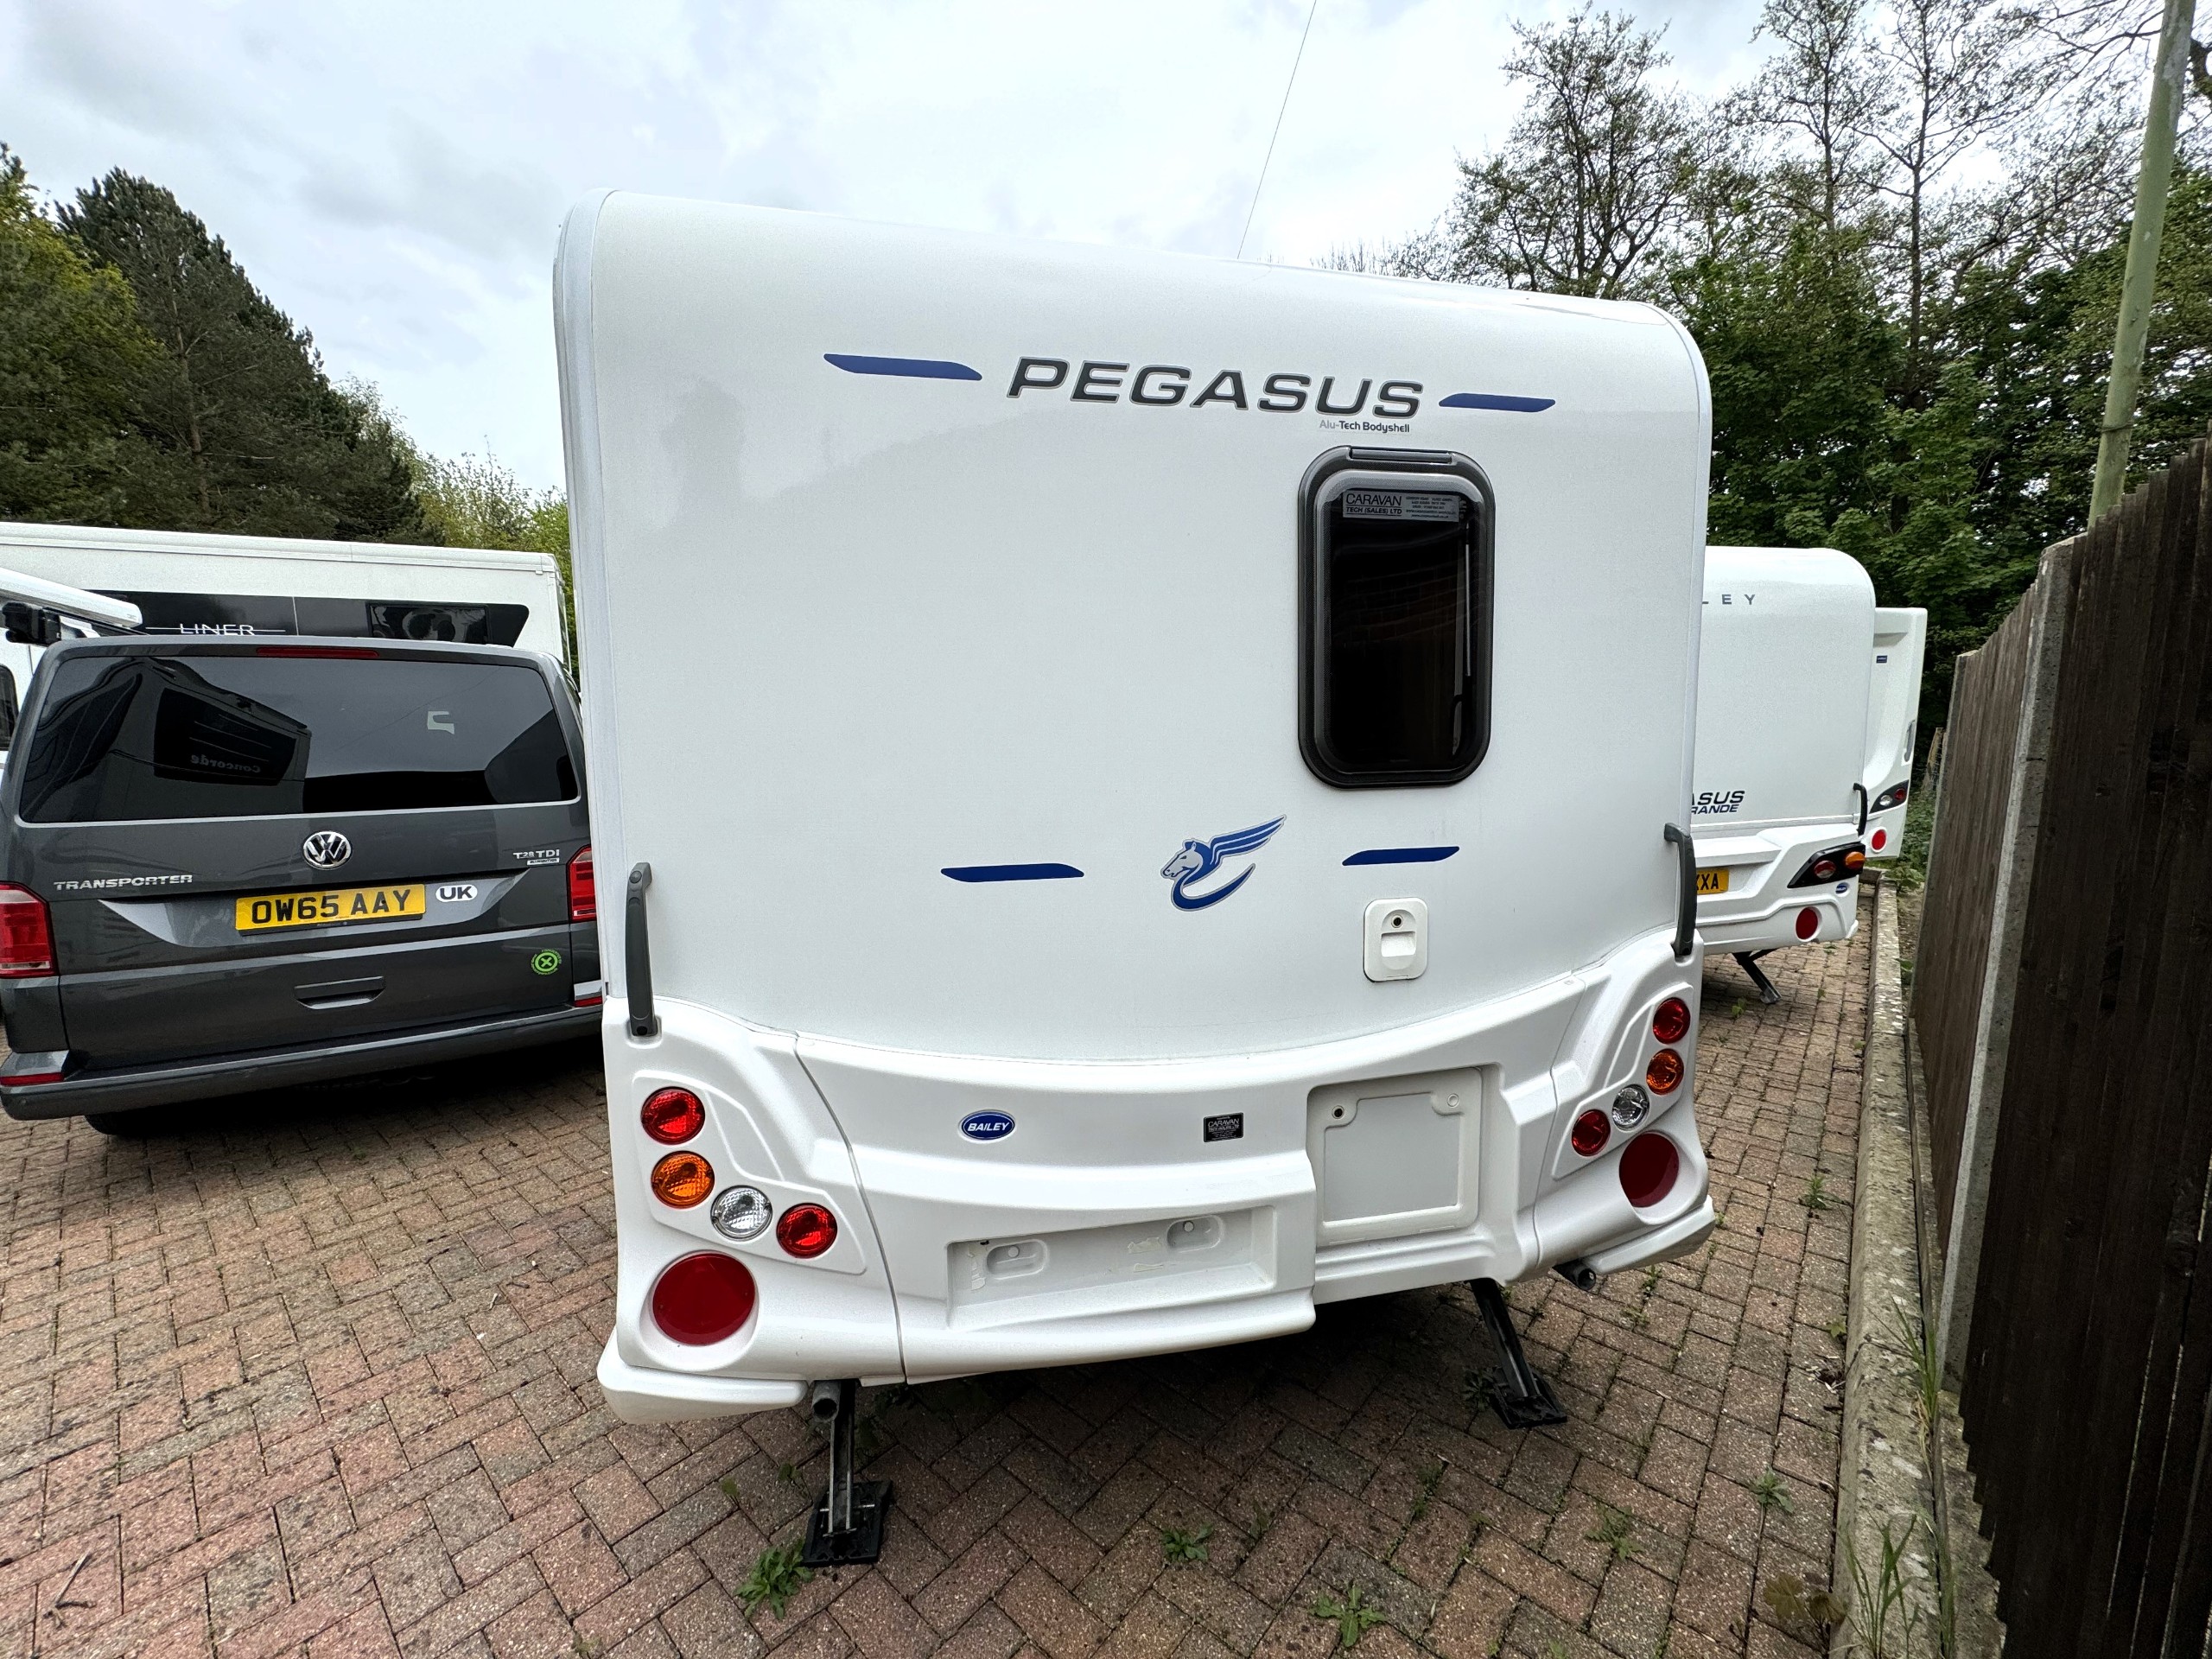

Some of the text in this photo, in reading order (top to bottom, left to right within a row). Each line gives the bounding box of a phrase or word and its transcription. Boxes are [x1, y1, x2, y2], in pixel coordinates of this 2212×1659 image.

[1007, 356, 1423, 419] PEGASUS
[1319, 419, 1410, 434] Alu-Tech Bodyshell
[1346, 493, 1402, 506] CARAVAN
[1364, 507, 1389, 516] (SALES)
[180, 623, 255, 636] LINER
[536, 849, 560, 858] TDI
[53, 874, 193, 891] TRANSPORTER
[439, 886, 474, 900] UK
[251, 888, 411, 925] OW65 AAY
[967, 1122, 1010, 1132] BAILEY
[1208, 1118, 1240, 1128] CARAVAN
